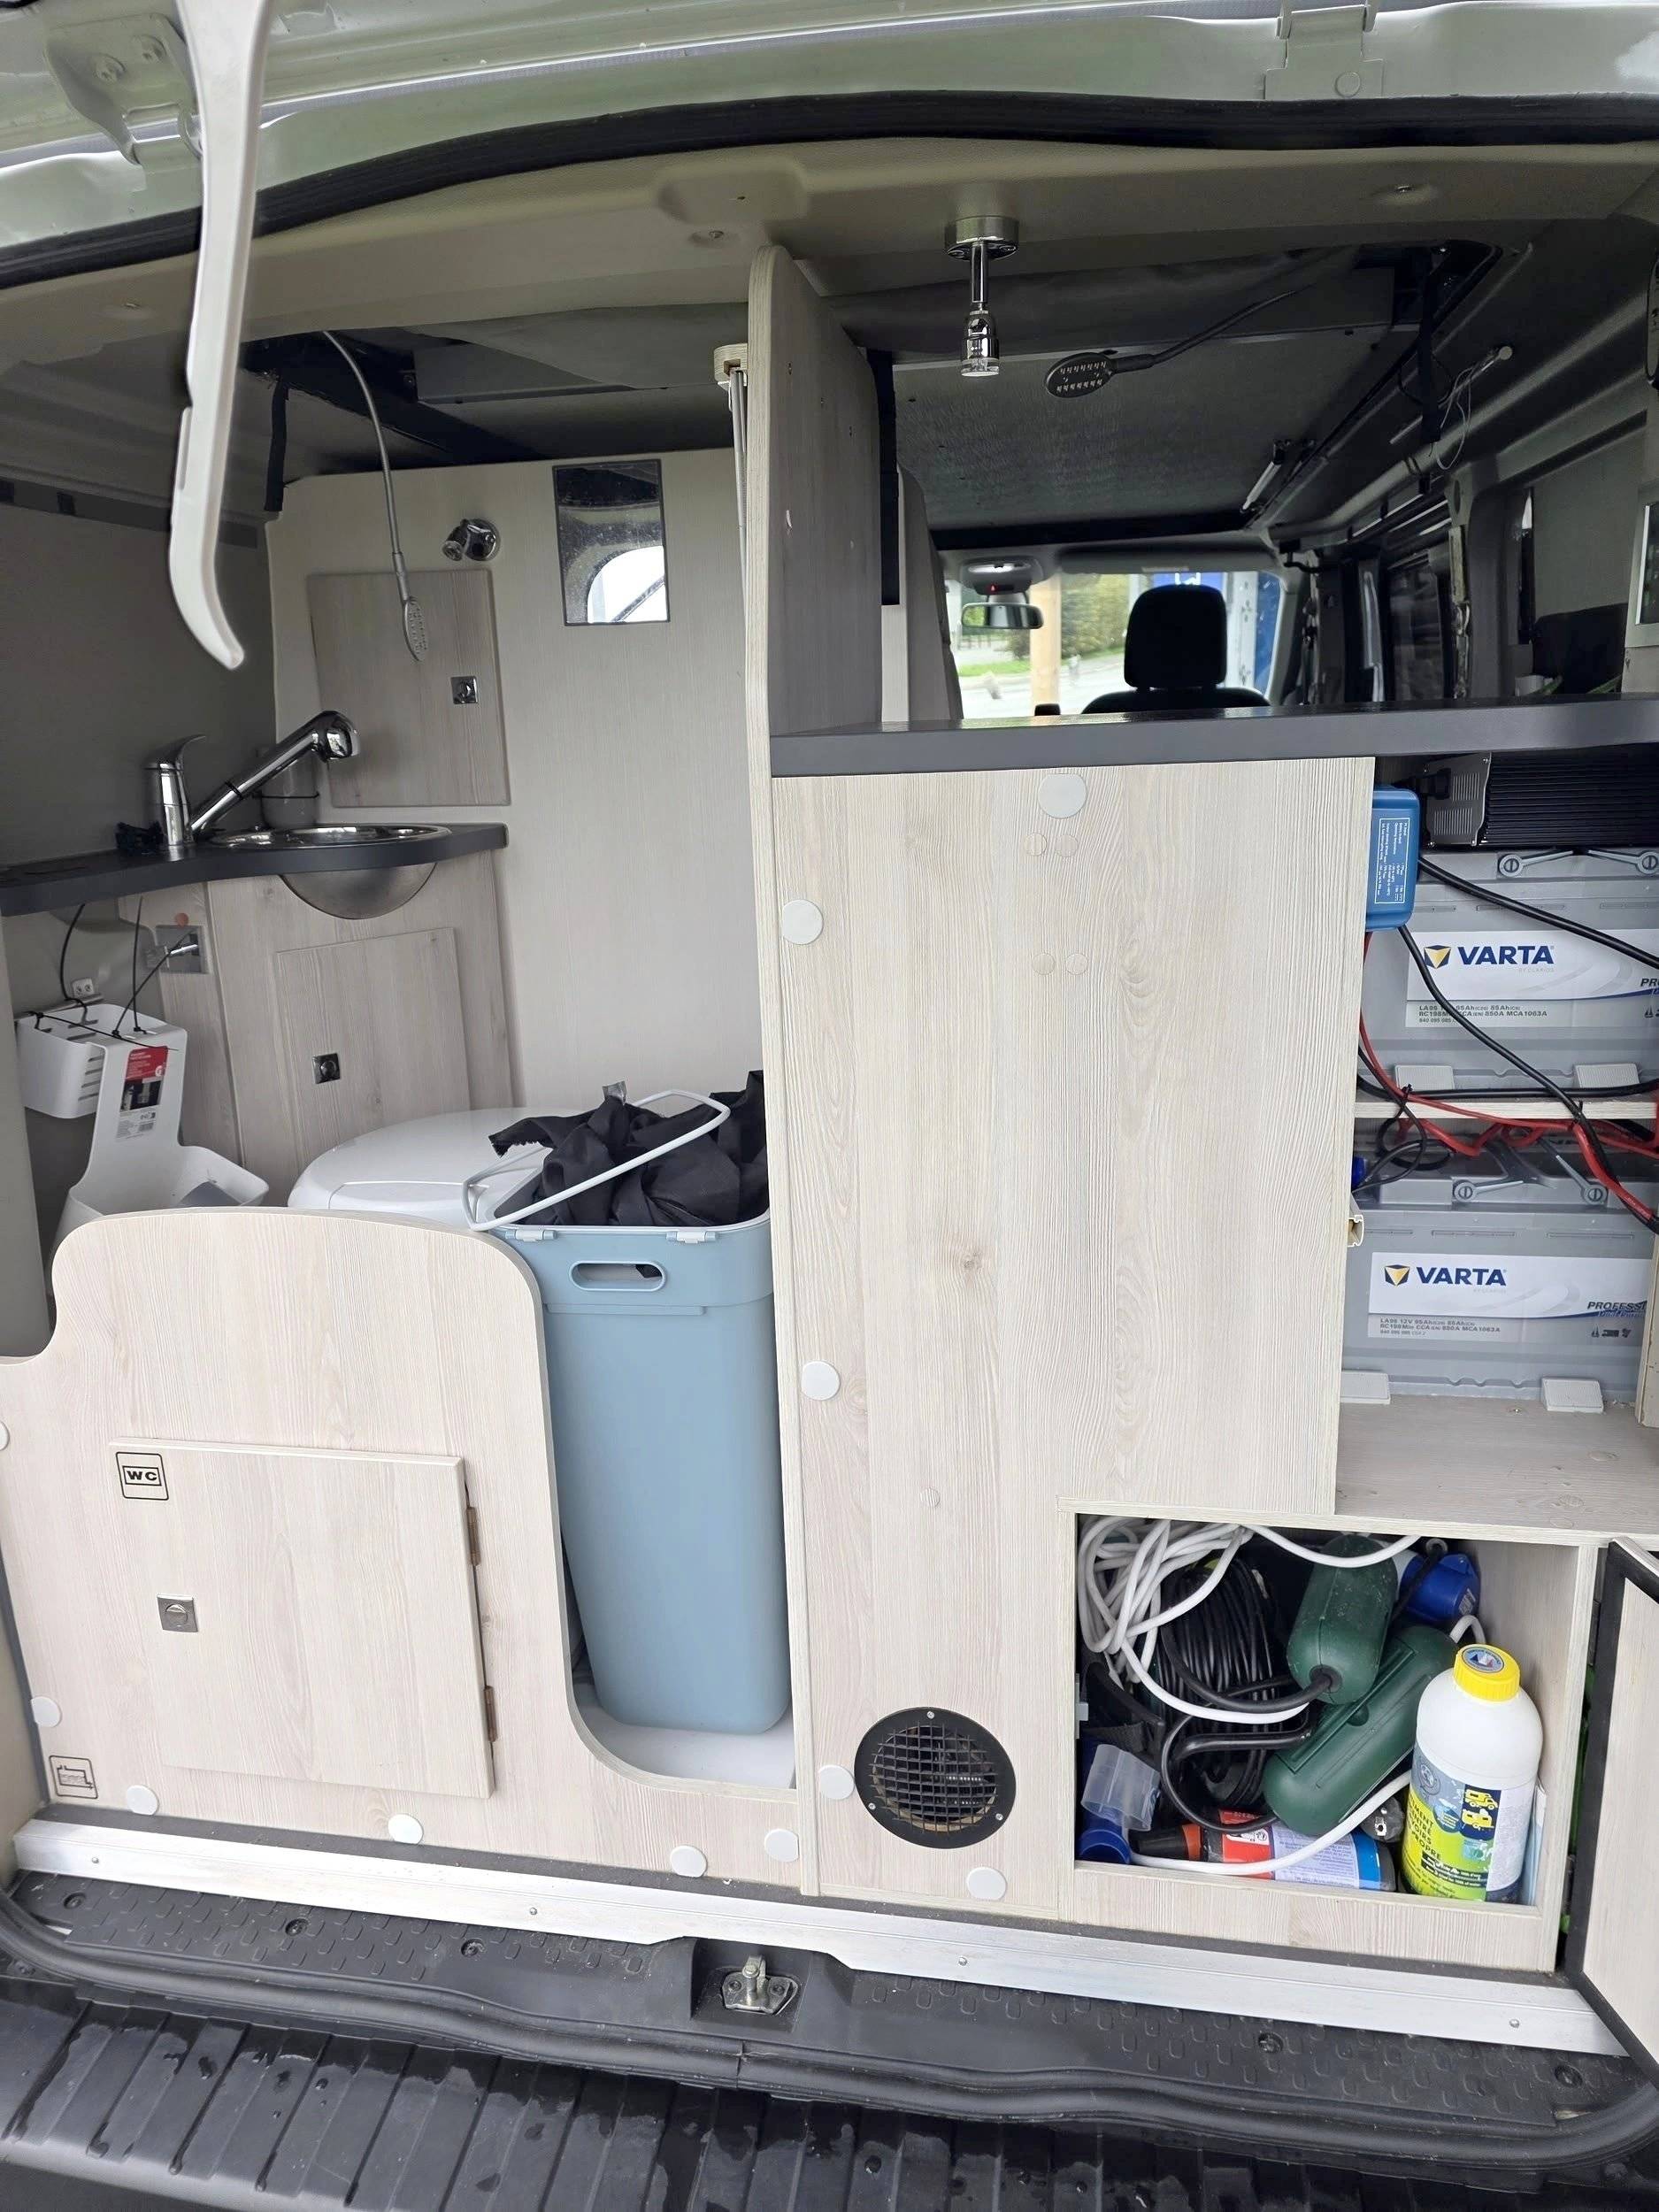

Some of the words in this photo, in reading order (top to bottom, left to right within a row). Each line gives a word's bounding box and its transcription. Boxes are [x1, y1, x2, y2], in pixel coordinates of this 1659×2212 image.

[1457, 946, 1555, 965] VARTA
[1640, 978, 1659, 987] PR
[1416, 1266, 1507, 1286] VARTA
[127, 1470, 157, 1481] WC
